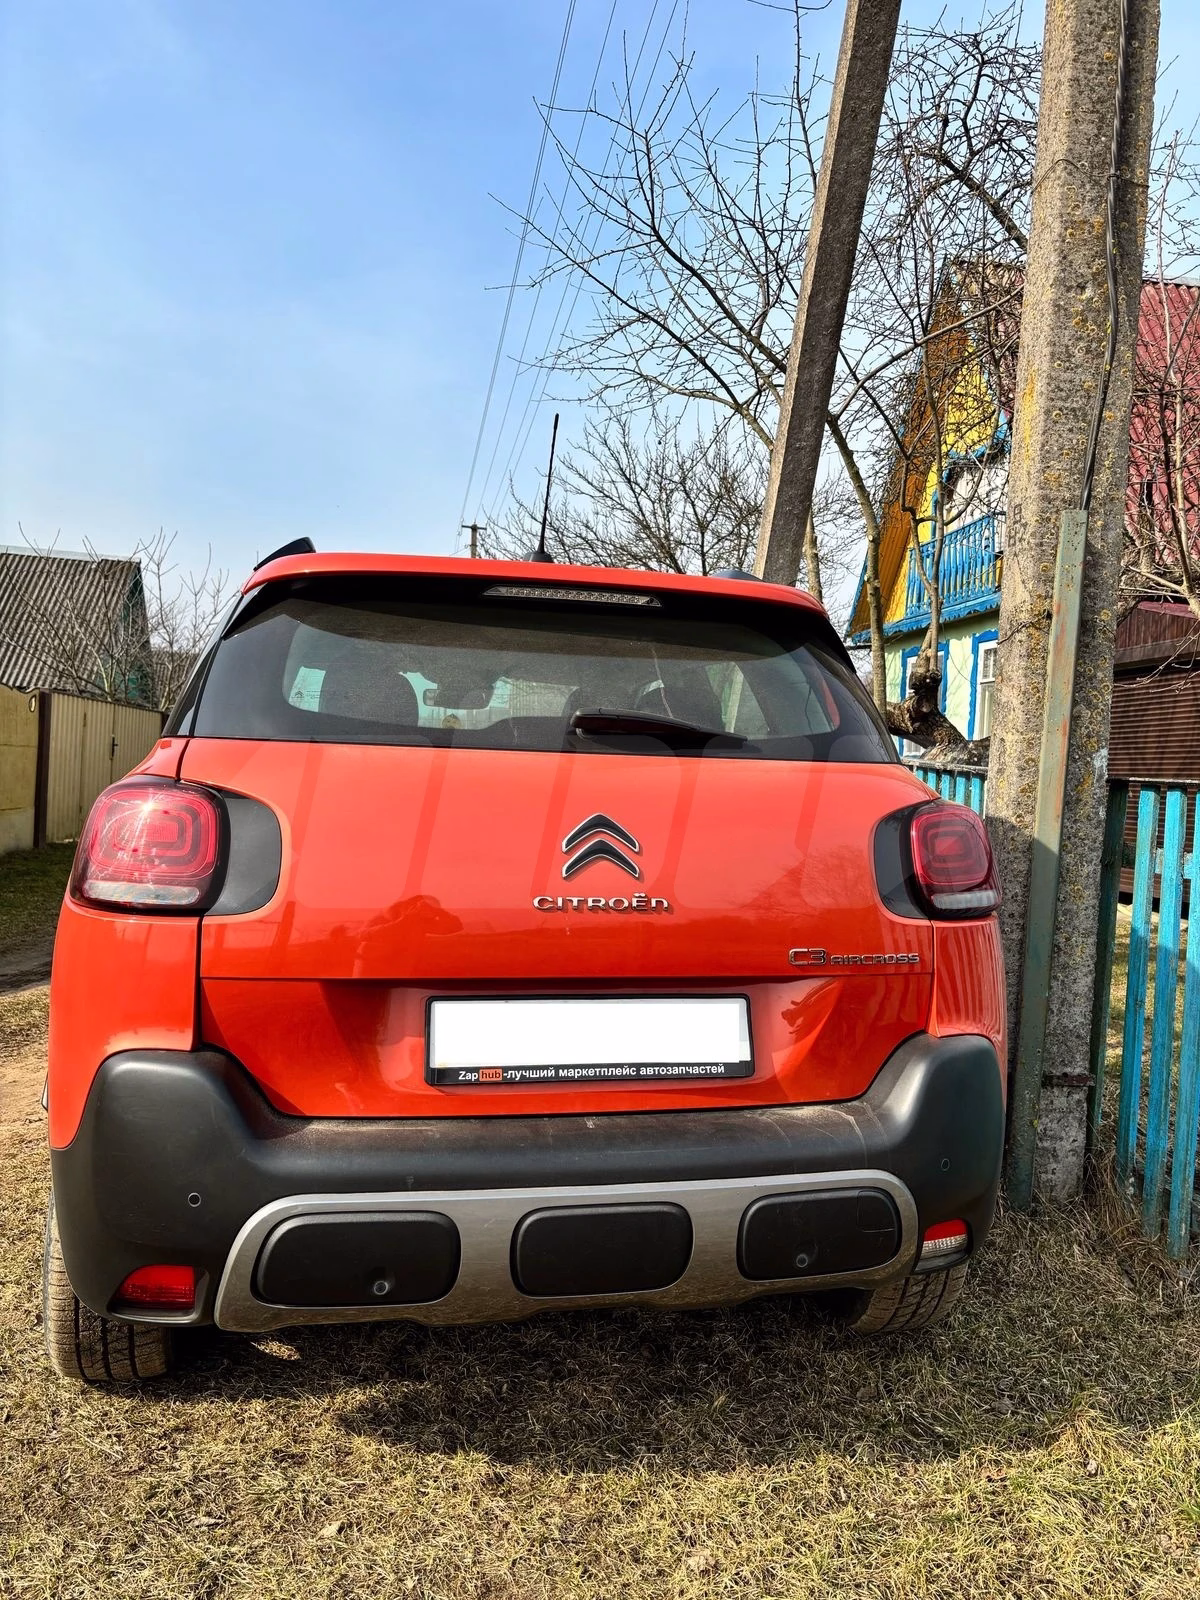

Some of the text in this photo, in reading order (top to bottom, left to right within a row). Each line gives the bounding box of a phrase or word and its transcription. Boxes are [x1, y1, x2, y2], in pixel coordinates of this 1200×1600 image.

[789, 948, 920, 965] C3 AIRCROSS
[558, 1065, 637, 1078] маркетплейс
[639, 1063, 725, 1075] автозапчастей
